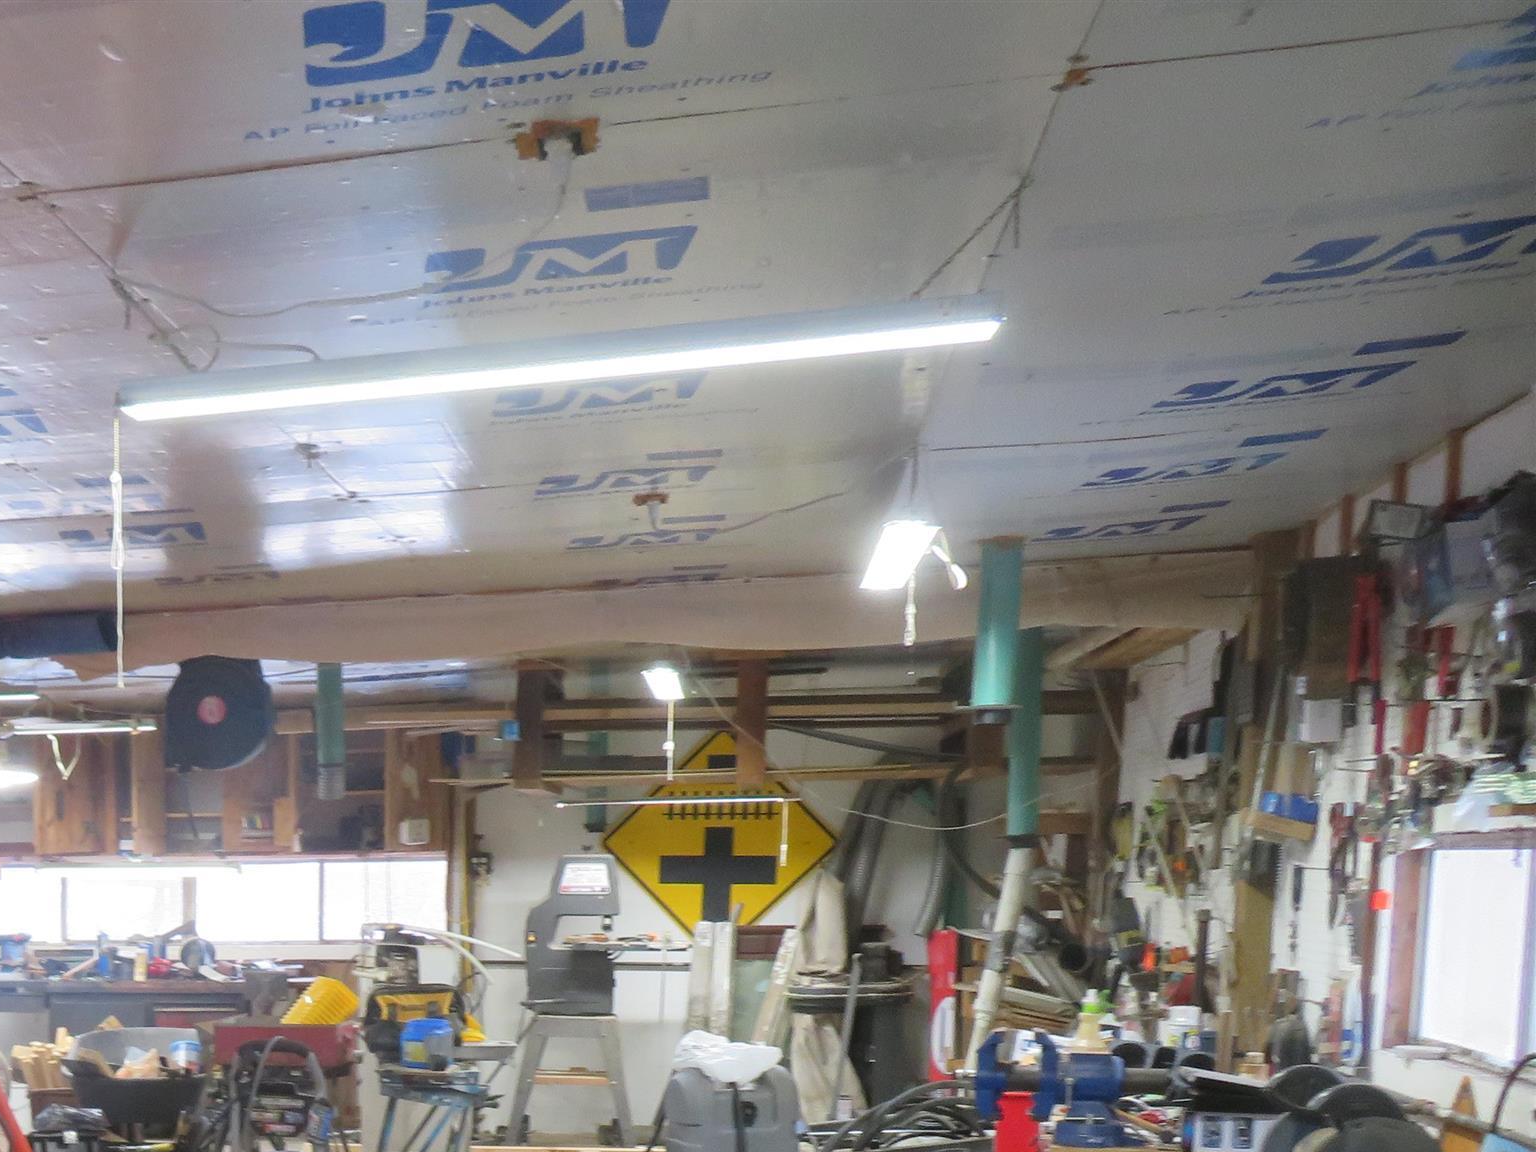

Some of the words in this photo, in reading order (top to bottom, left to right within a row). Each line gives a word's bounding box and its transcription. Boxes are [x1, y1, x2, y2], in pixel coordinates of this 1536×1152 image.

[302, 0, 669, 88] JM
[302, 84, 436, 115] Johns
[444, 57, 650, 95] Manville
[588, 69, 773, 100] Sheathing
[424, 224, 699, 296] JM
[523, 276, 674, 298] Manville
